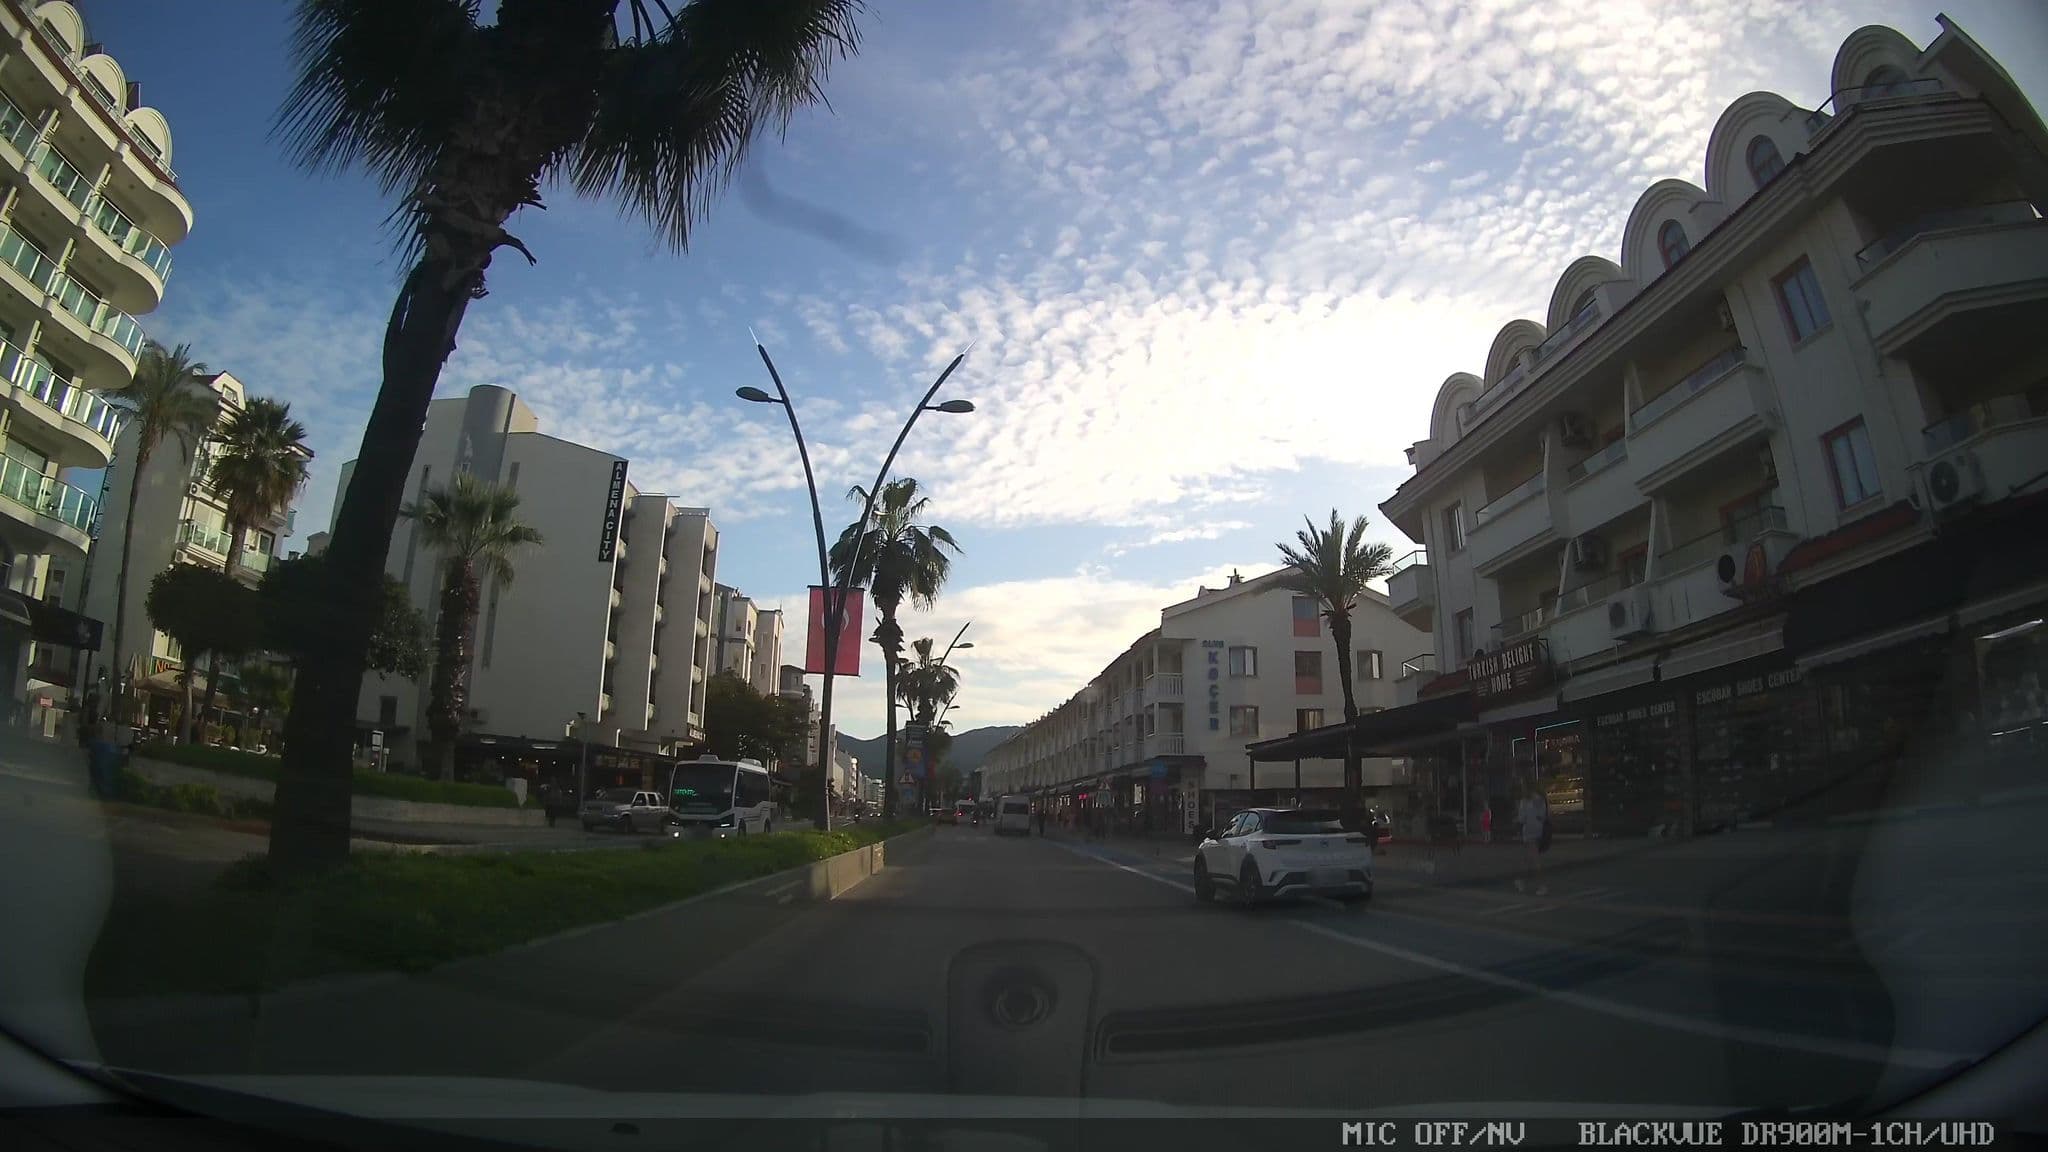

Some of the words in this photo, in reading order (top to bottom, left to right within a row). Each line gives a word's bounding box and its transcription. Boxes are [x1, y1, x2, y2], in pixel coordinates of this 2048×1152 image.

[608, 462, 623, 518] ALMENA
[602, 521, 615, 560] CITY
[1467, 656, 1499, 680] TURKISH
[1502, 643, 1533, 670] DELIGHT
[1491, 672, 1512, 694] HOME
[1696, 687, 1731, 705] ESCOBAR
[1736, 677, 1764, 697] SHOES
